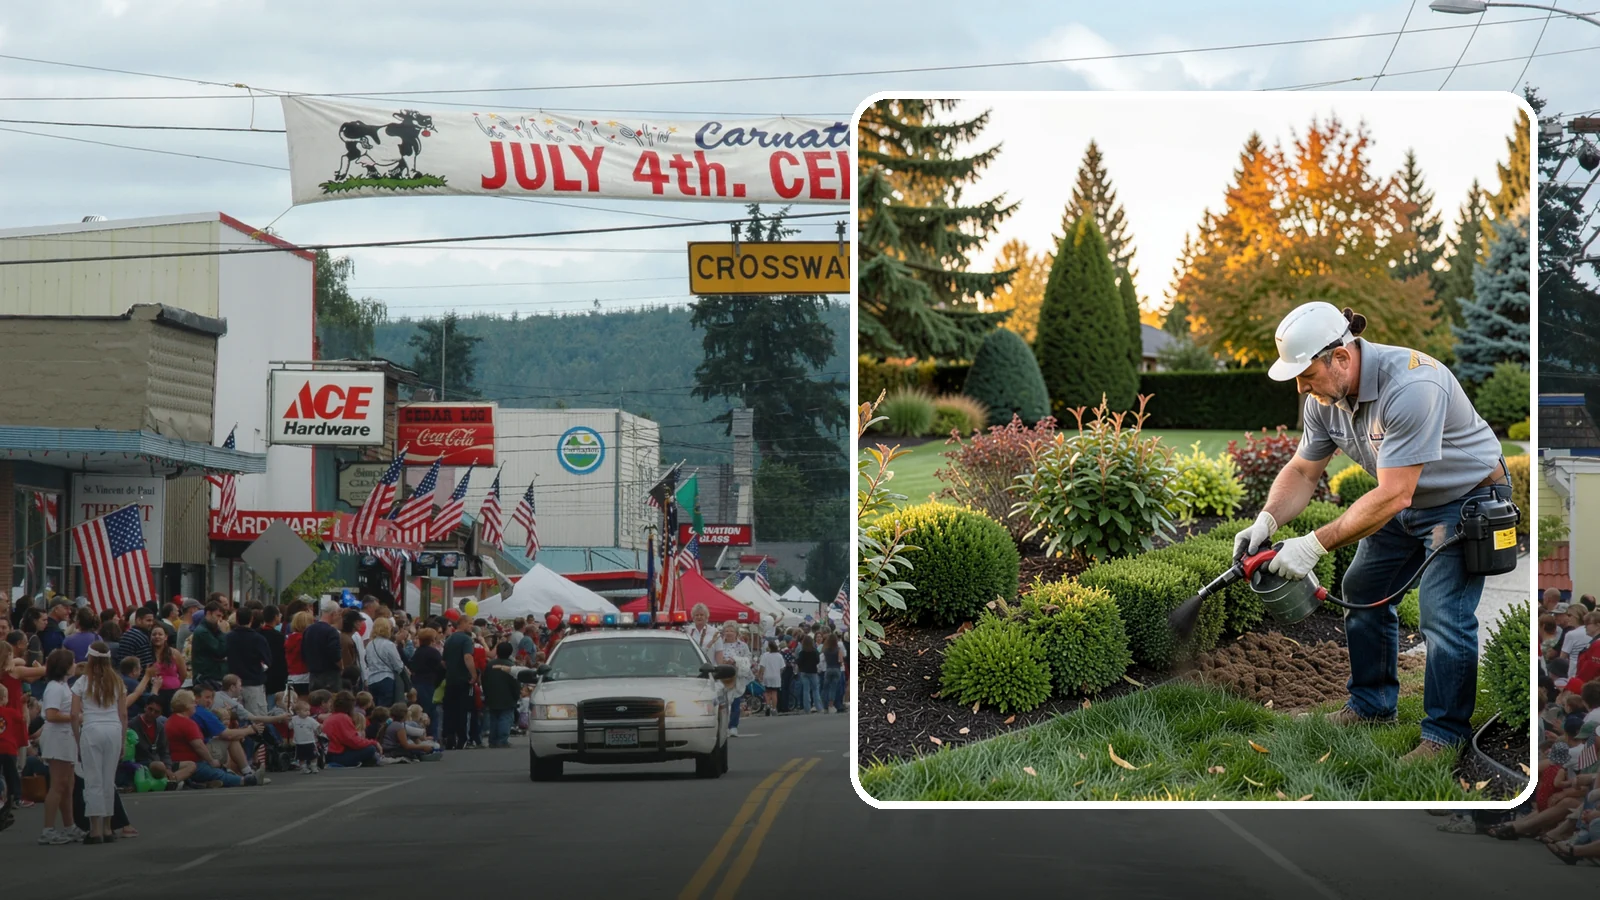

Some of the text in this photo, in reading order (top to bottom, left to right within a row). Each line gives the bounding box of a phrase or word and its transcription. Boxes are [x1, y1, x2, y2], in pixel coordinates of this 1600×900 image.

[694, 121, 850, 150] Carnat
[481, 140, 605, 193] JULY
[632, 150, 746, 197] 4th.
[697, 254, 850, 280] CROSSWA
[282, 380, 374, 420] ACE
[405, 409, 485, 423] CEDAR LOG
[283, 421, 371, 436] Hardware
[416, 428, 477, 447] Coca-Cola
[353, 467, 388, 480] Simpl
[83, 484, 155, 495] St. Vincent de Paul
[688, 526, 742, 535] CRNATION
[699, 535, 730, 544] GLASS
